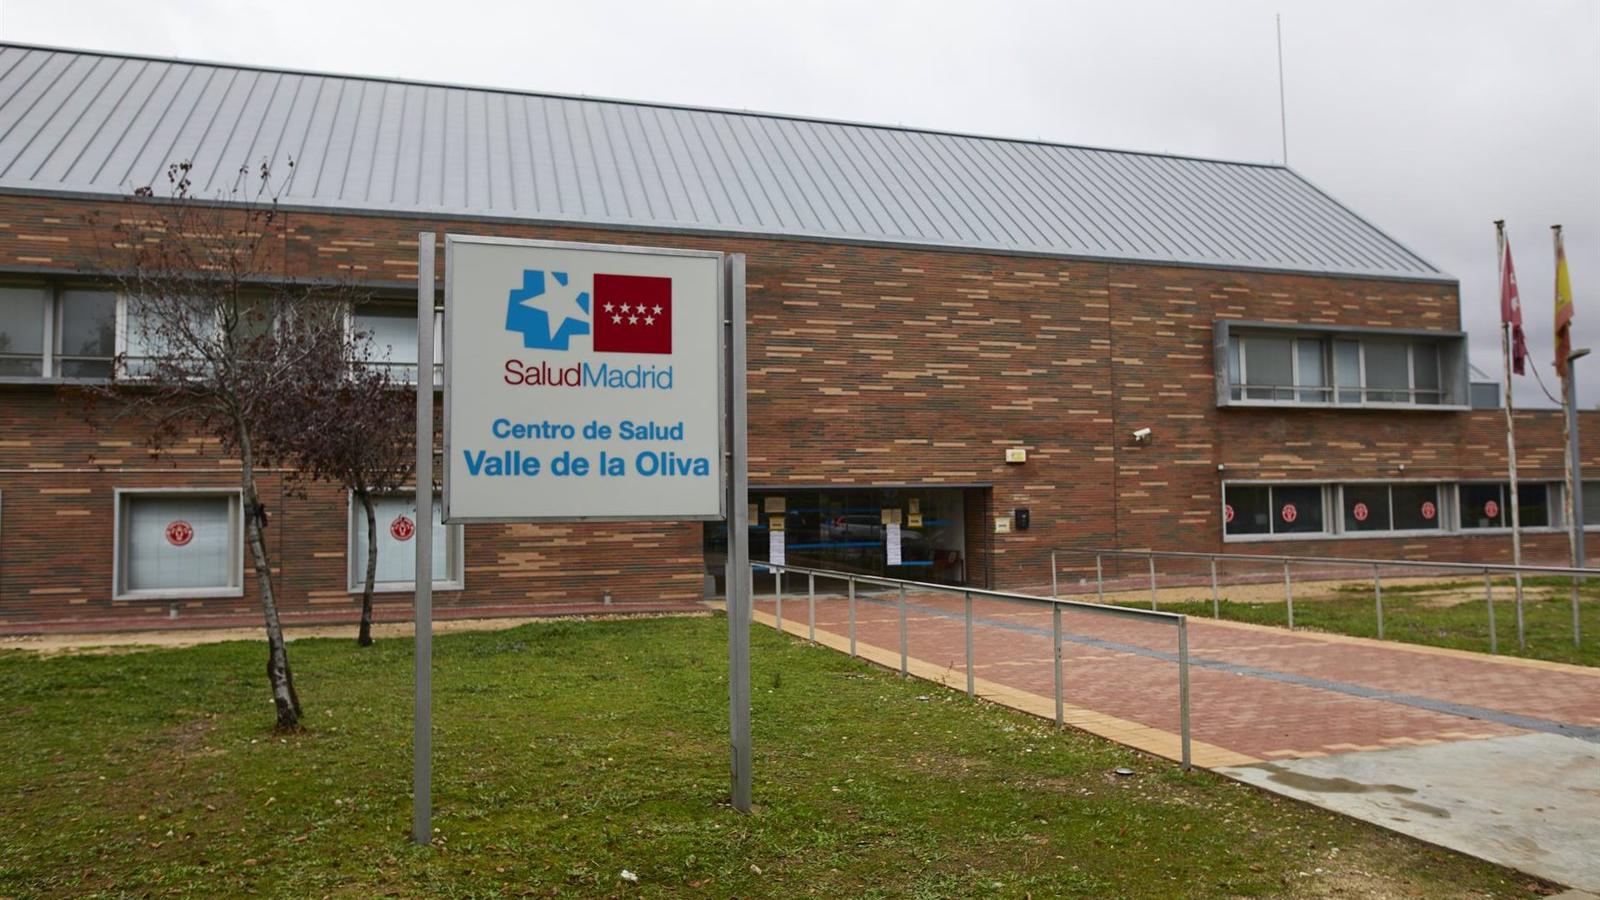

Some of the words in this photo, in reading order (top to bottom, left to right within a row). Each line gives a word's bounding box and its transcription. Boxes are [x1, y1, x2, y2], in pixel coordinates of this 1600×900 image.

[492, 418, 576, 440] Centro
[582, 420, 612, 440] de
[619, 420, 684, 441] Salud
[463, 450, 541, 477] Valle
[550, 451, 590, 477] de
[599, 451, 626, 477] la
[635, 451, 710, 477] Oliva
